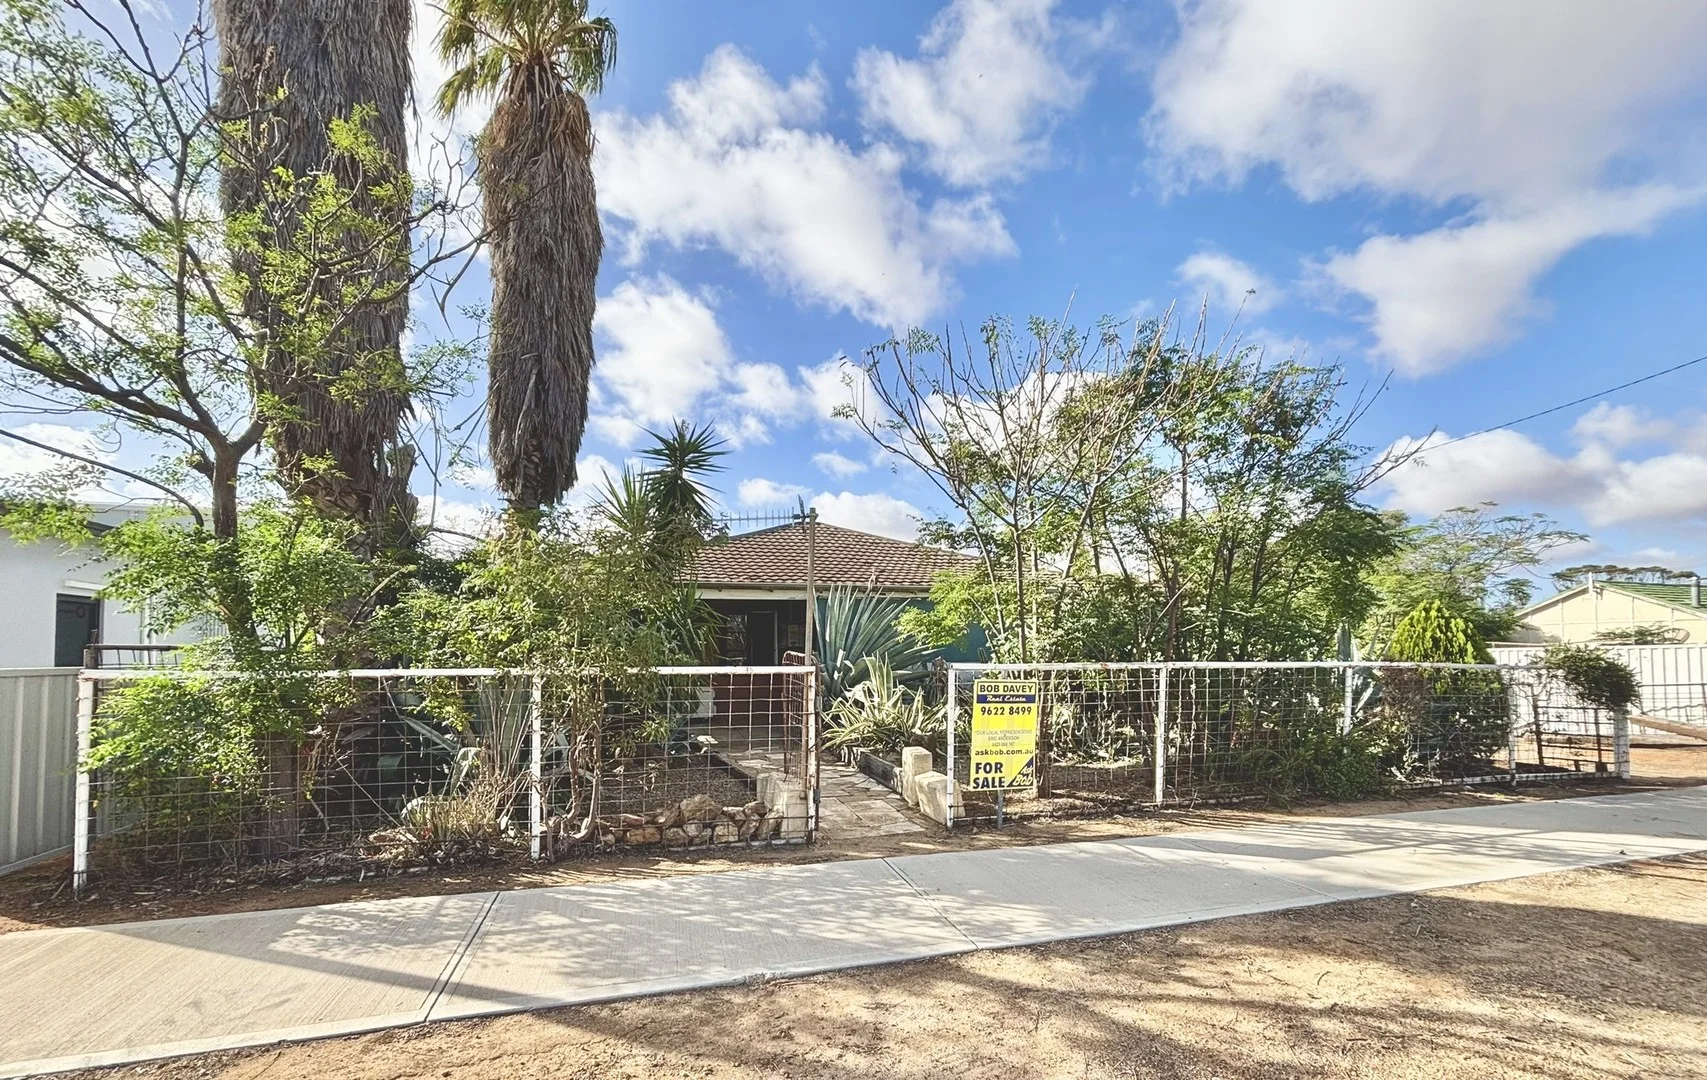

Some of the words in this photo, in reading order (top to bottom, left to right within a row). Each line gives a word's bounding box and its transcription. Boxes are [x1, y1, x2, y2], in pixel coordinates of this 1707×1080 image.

[980, 684, 1000, 693] BOB
[1003, 684, 1033, 693] DAVEY
[981, 706, 1005, 715] 9622
[1008, 706, 1032, 715] 8499
[975, 762, 1003, 774] FOR
[973, 777, 1005, 789] SALE
[1012, 774, 1033, 786] Bob
